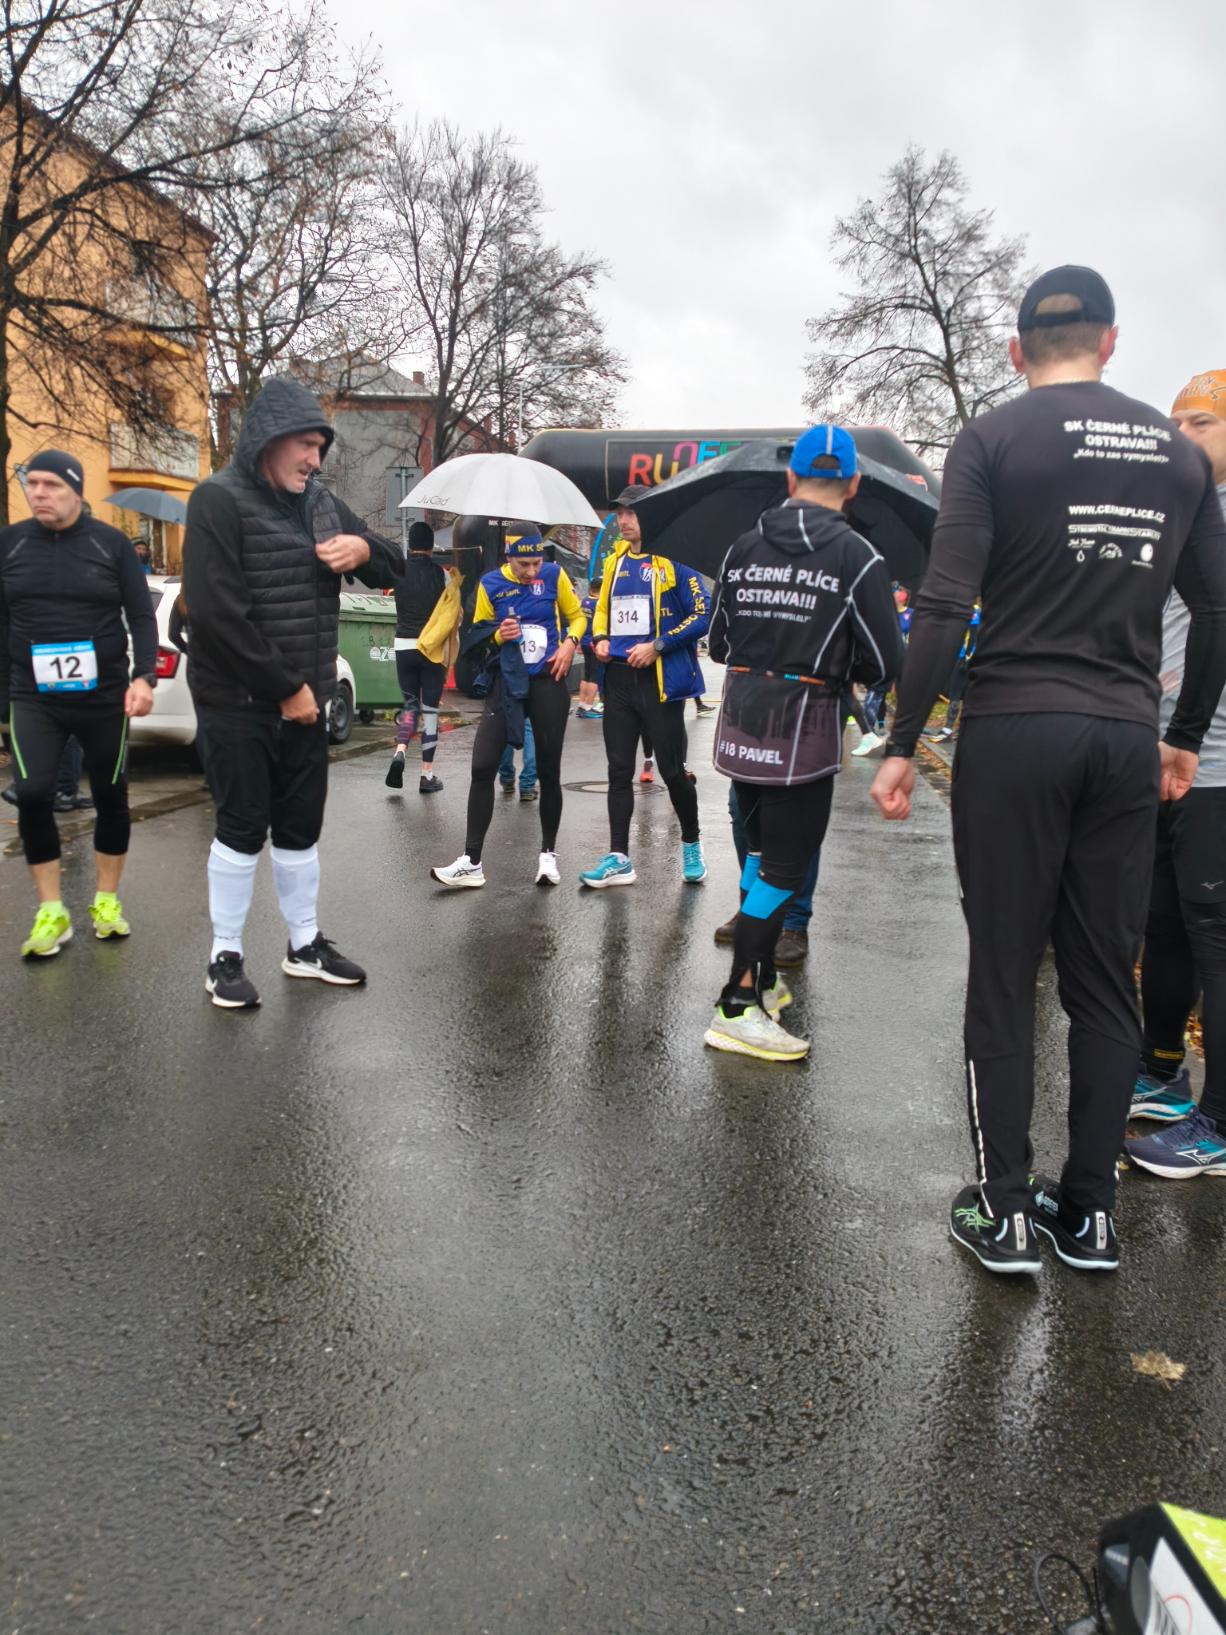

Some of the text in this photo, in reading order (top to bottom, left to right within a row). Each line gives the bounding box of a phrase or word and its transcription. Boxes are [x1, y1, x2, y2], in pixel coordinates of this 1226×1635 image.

[1063, 420, 1084, 432] SK
[1085, 418, 1131, 435] ČERNÉ
[1084, 434, 1158, 450] OSTRAVA!!!
[518, 544, 534, 552] MK
[688, 576, 702, 597] MK
[727, 563, 840, 593] SK ČERNÉ PLÍCE
[736, 588, 817, 611] OSTRAVA!!!
[617, 610, 639, 624] 314
[49, 655, 83, 679] 12
[738, 745, 784, 765] PAVEL
